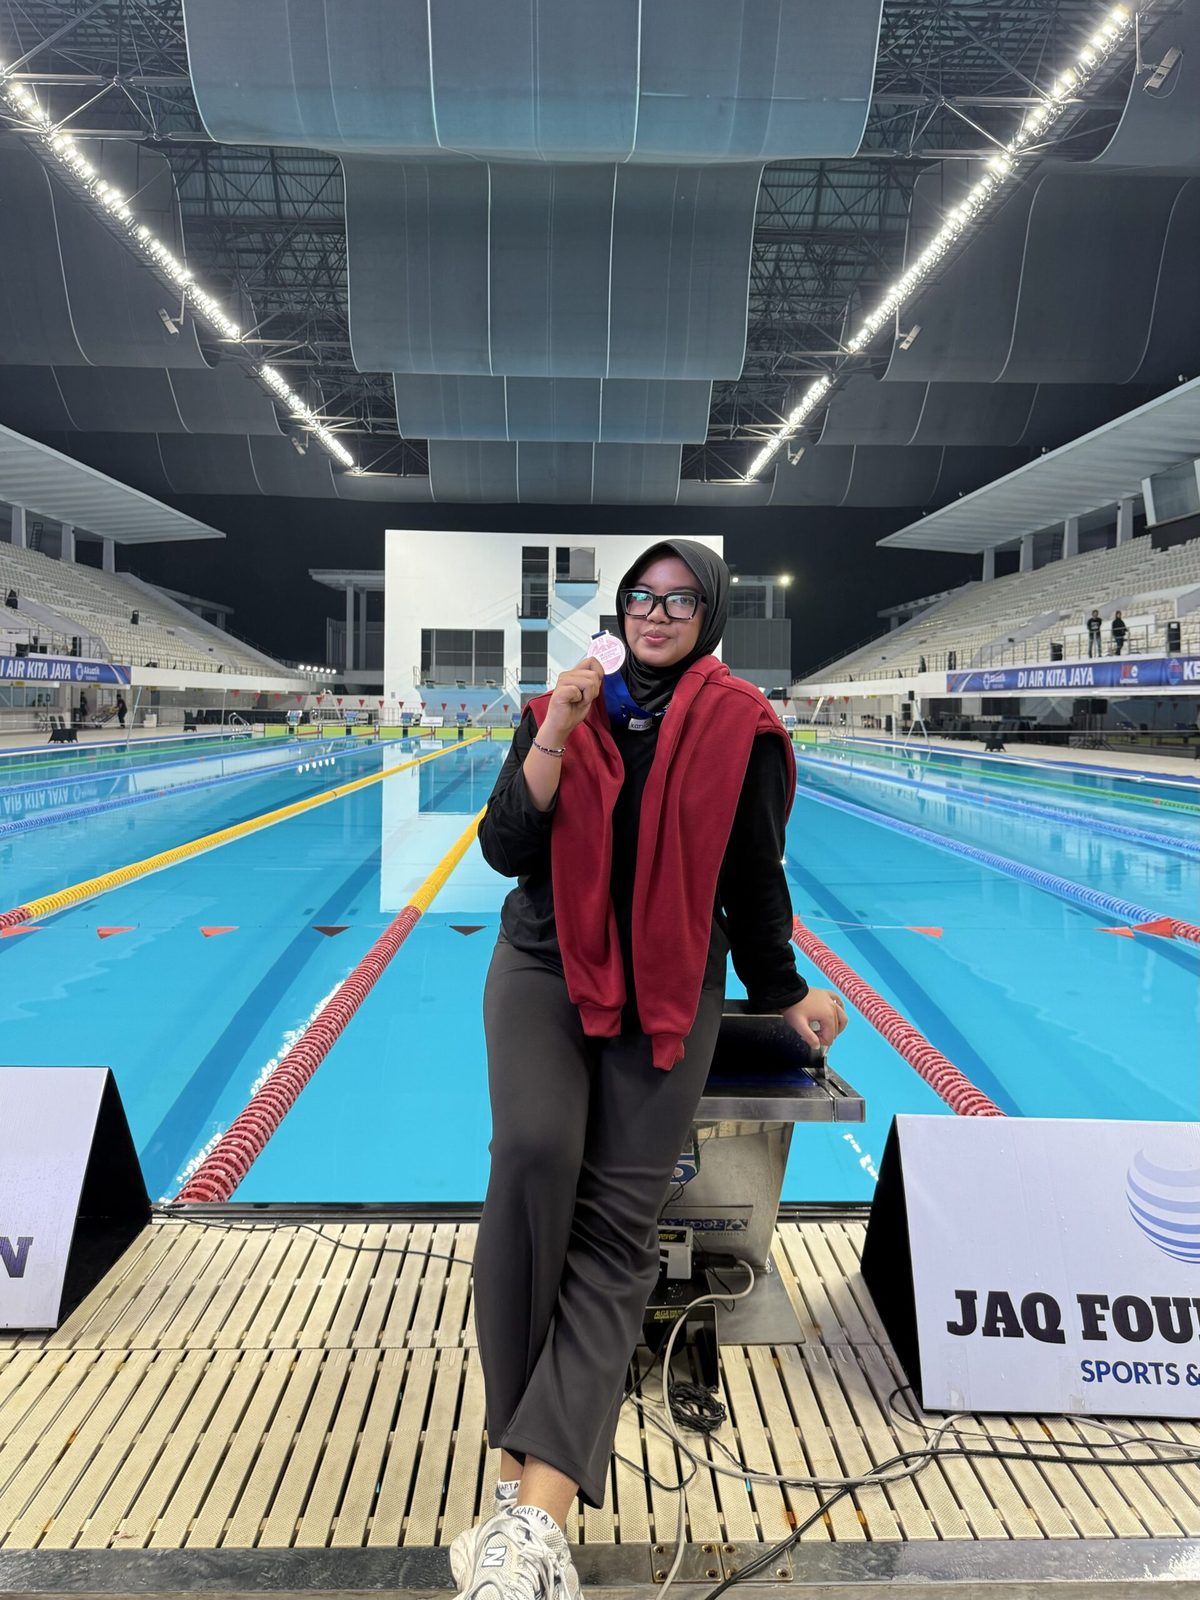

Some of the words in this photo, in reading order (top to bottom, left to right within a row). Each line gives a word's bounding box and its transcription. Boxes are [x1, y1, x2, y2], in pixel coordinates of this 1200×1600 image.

[6, 660, 24, 677] AIR
[27, 661, 48, 679] KITA
[50, 663, 71, 680] JAYA
[1017, 672, 1027, 688] DI
[1028, 670, 1044, 687] AIR
[1045, 668, 1066, 686] KITA
[1068, 667, 1094, 686] JAYA
[946, 1289, 1066, 1344] JAQ
[1076, 1293, 1200, 1344] FOU
[1080, 1359, 1180, 1386] SPORTS
[1185, 1363, 1200, 1386] &
